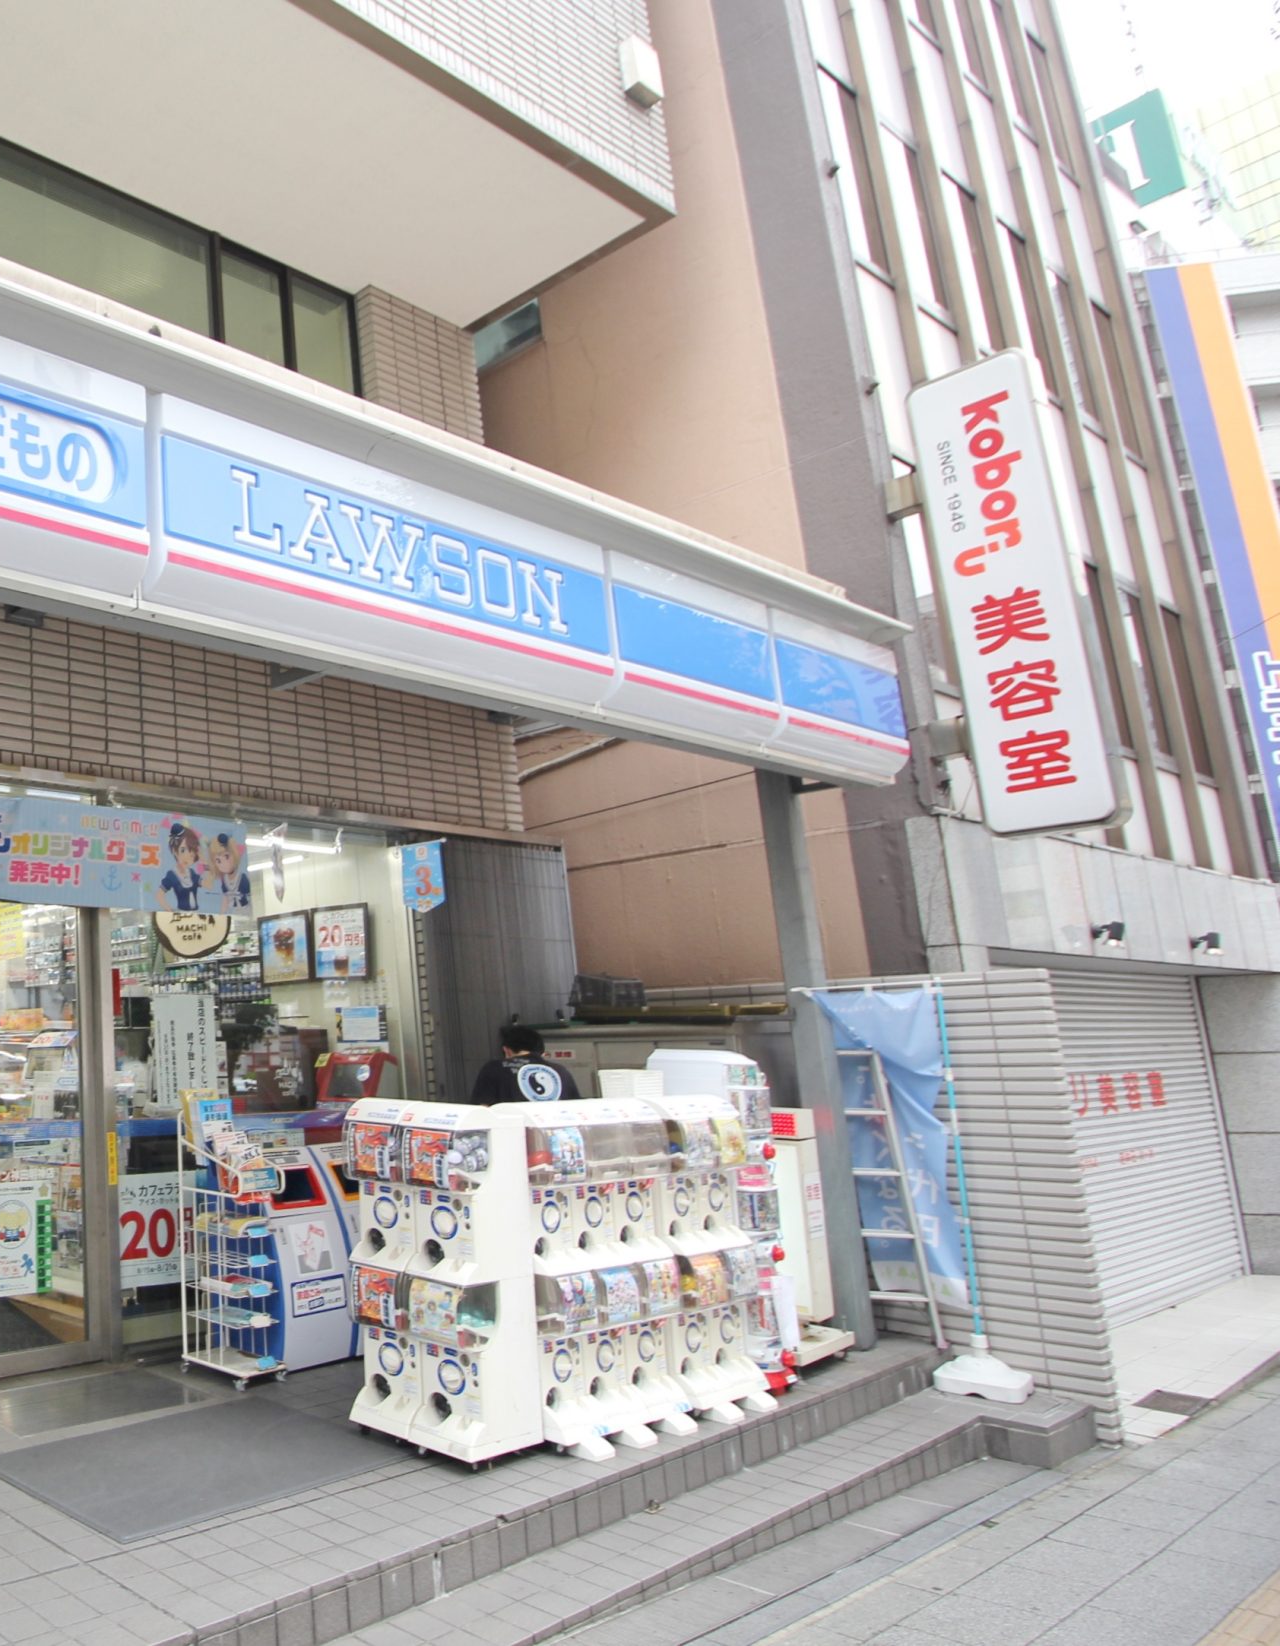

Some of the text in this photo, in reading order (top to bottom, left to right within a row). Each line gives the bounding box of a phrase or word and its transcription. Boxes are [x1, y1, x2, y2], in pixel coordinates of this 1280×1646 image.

[230, 464, 570, 636] LAWSON
[936, 441, 965, 533] SINCE 1946
[971, 586, 1078, 793] 美容室
[176, 924, 207, 932] MACHI
